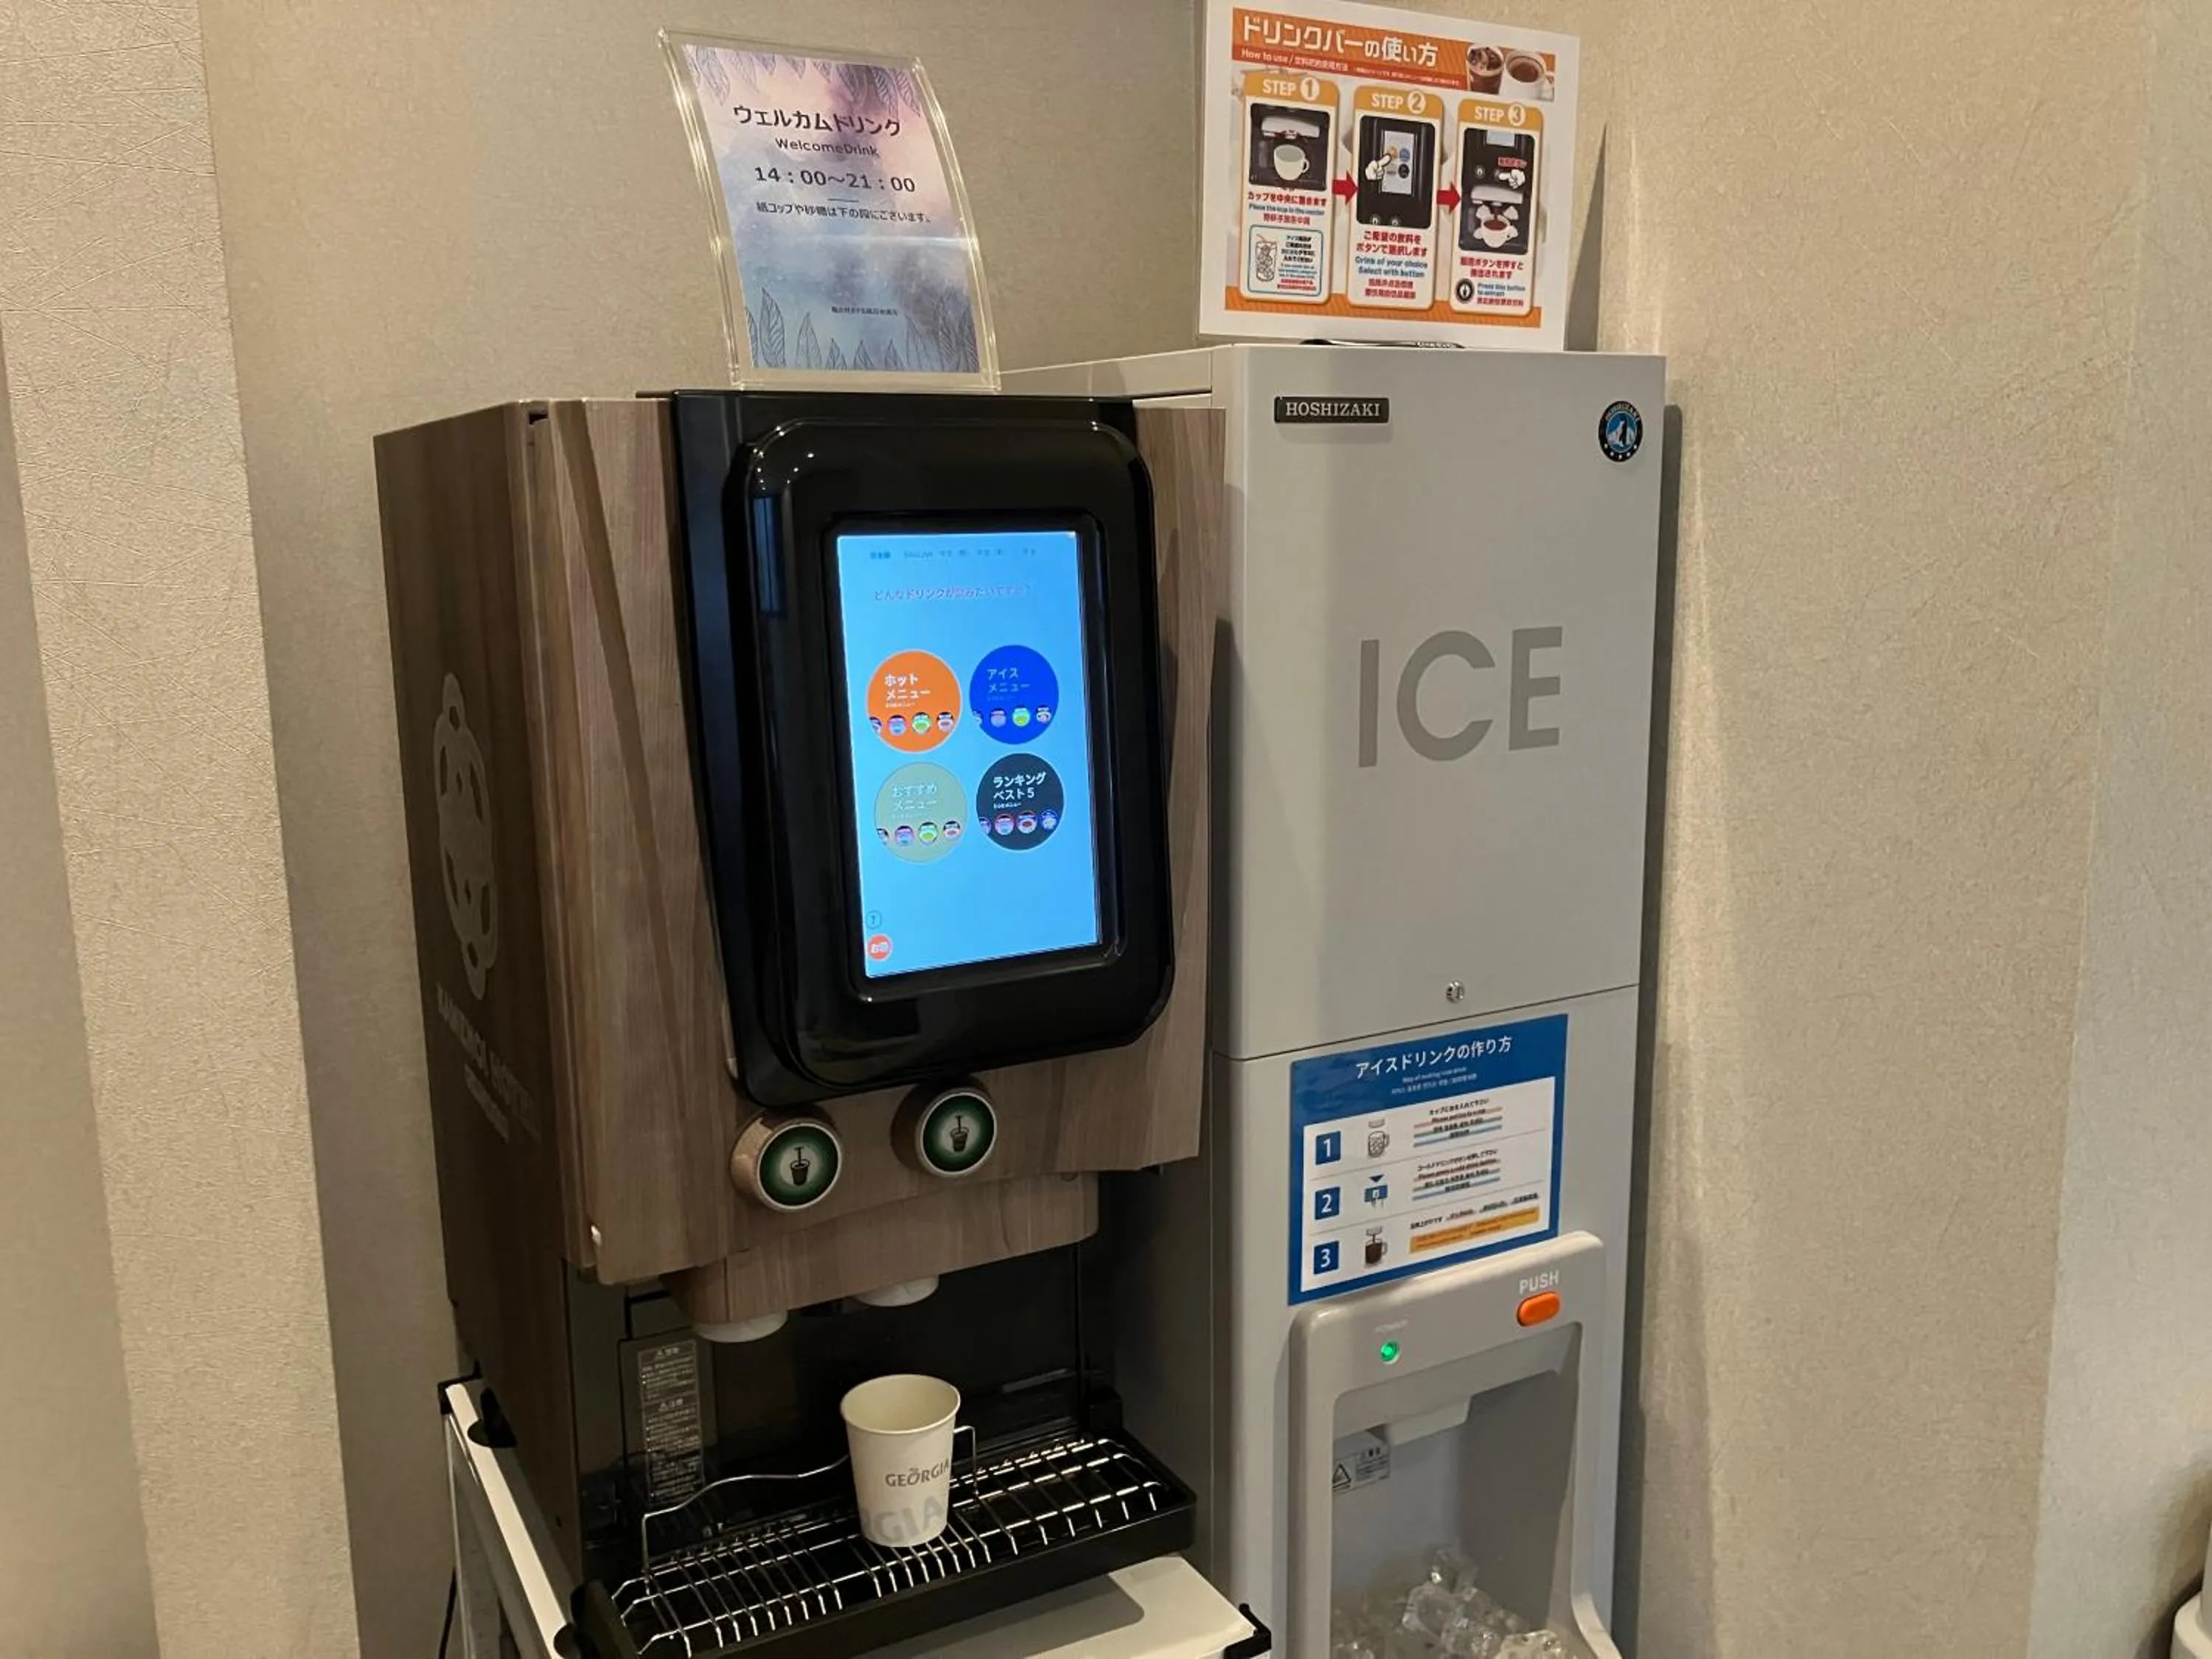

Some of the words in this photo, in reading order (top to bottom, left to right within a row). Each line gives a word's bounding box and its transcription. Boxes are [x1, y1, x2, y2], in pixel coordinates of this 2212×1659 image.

[1244, 15, 1438, 67] ドリンクバーの使い方
[1242, 48, 1261, 59] How
[1263, 52, 1272, 61] to
[1263, 78, 1296, 95] STEP
[1371, 93, 1403, 110] STEP
[734, 105, 900, 136] ウェルカムドリンク
[1475, 105, 1504, 122] STEP
[776, 138, 880, 157] WelcomeDrink
[1286, 402, 1380, 417] HOSHIZAKI
[885, 673, 918, 686] ホット
[987, 667, 1019, 681] アイス
[886, 689, 931, 701] メニュー
[988, 683, 1030, 693] メニュー
[1359, 626, 1562, 768] ICE
[993, 771, 1046, 787] ランキング
[894, 799, 937, 811] メニュー
[1357, 1035, 1512, 1079] アイスドリンクの作り方
[1324, 1138, 1332, 1157] 1
[1321, 1194, 1332, 1214] 2
[1321, 1248, 1331, 1268] 3
[1519, 1270, 1559, 1294] PUSH
